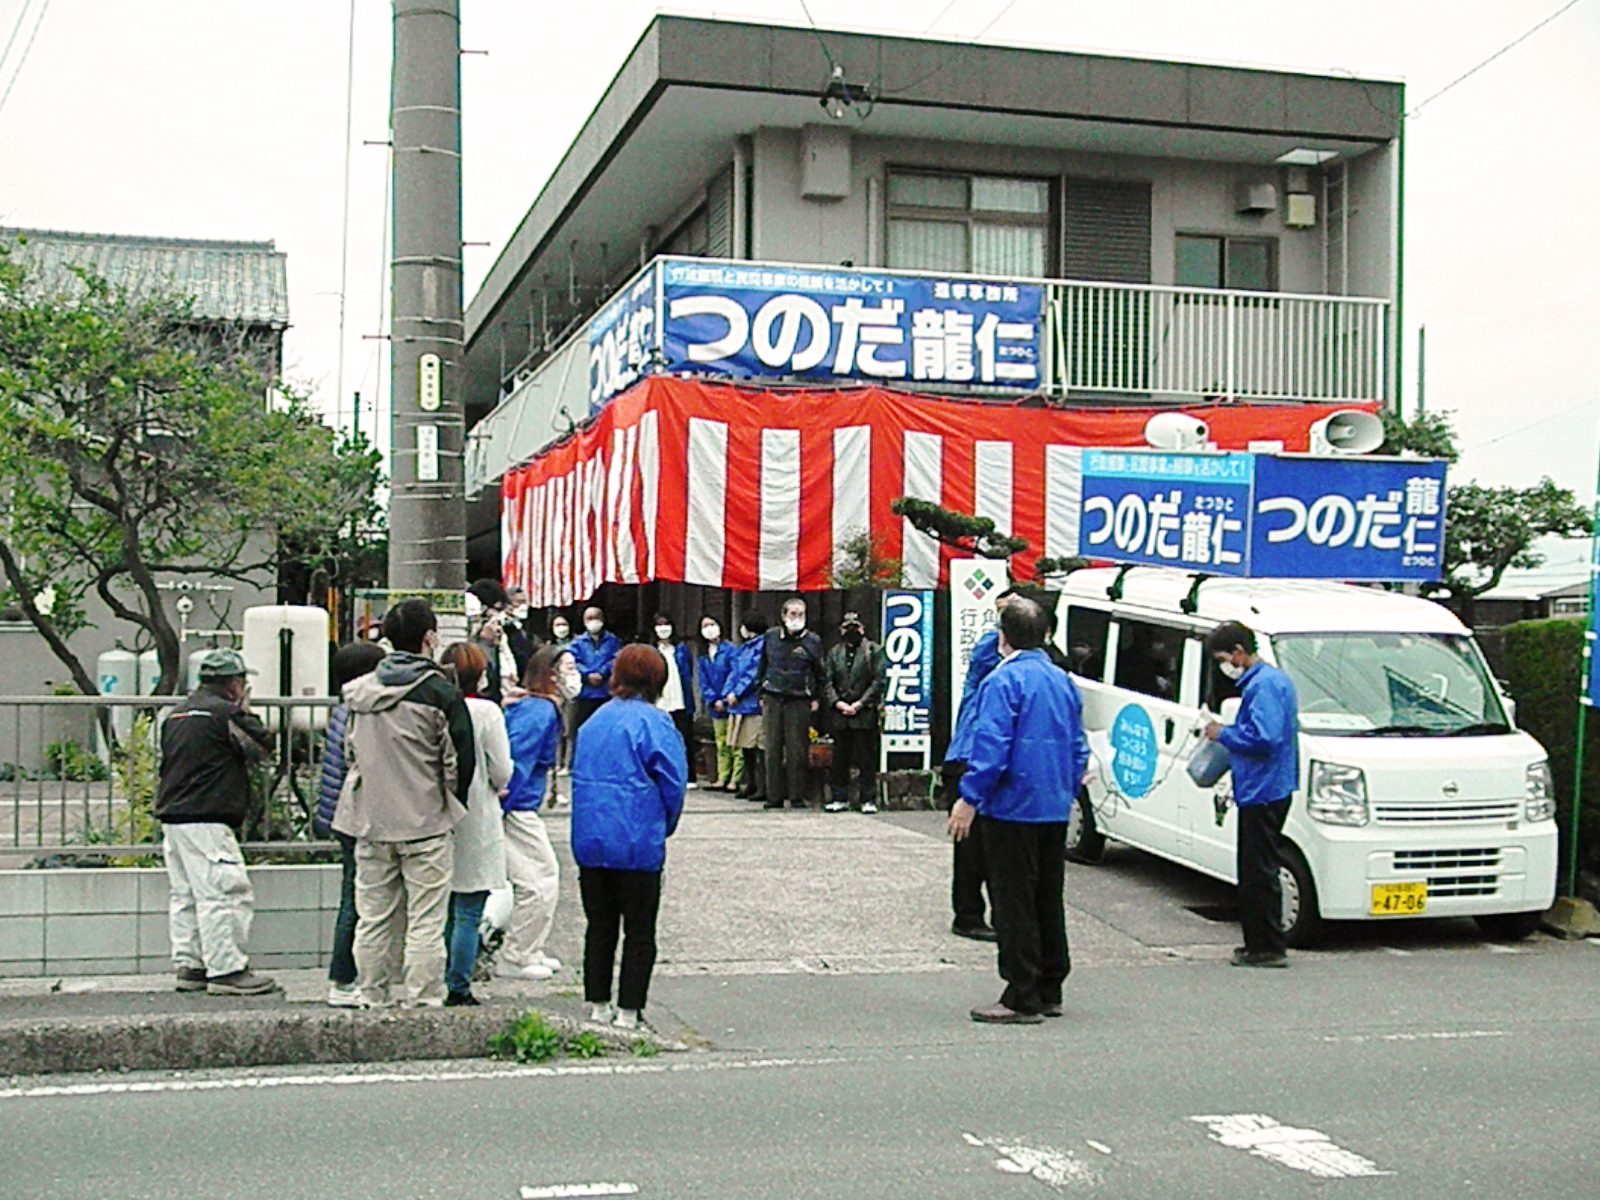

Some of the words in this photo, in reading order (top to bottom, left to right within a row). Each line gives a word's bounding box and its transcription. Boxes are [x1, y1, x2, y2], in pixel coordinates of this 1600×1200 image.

[670, 293, 1037, 383] つのだ龍仁
[1084, 490, 1242, 565] つのだ龍仁
[1258, 491, 1401, 550] つのだ
[1402, 477, 1441, 555] 龍仁
[886, 595, 922, 702] つのだ
[884, 705, 930, 731] 龍仁
[1383, 894, 1425, 910] 47-06
